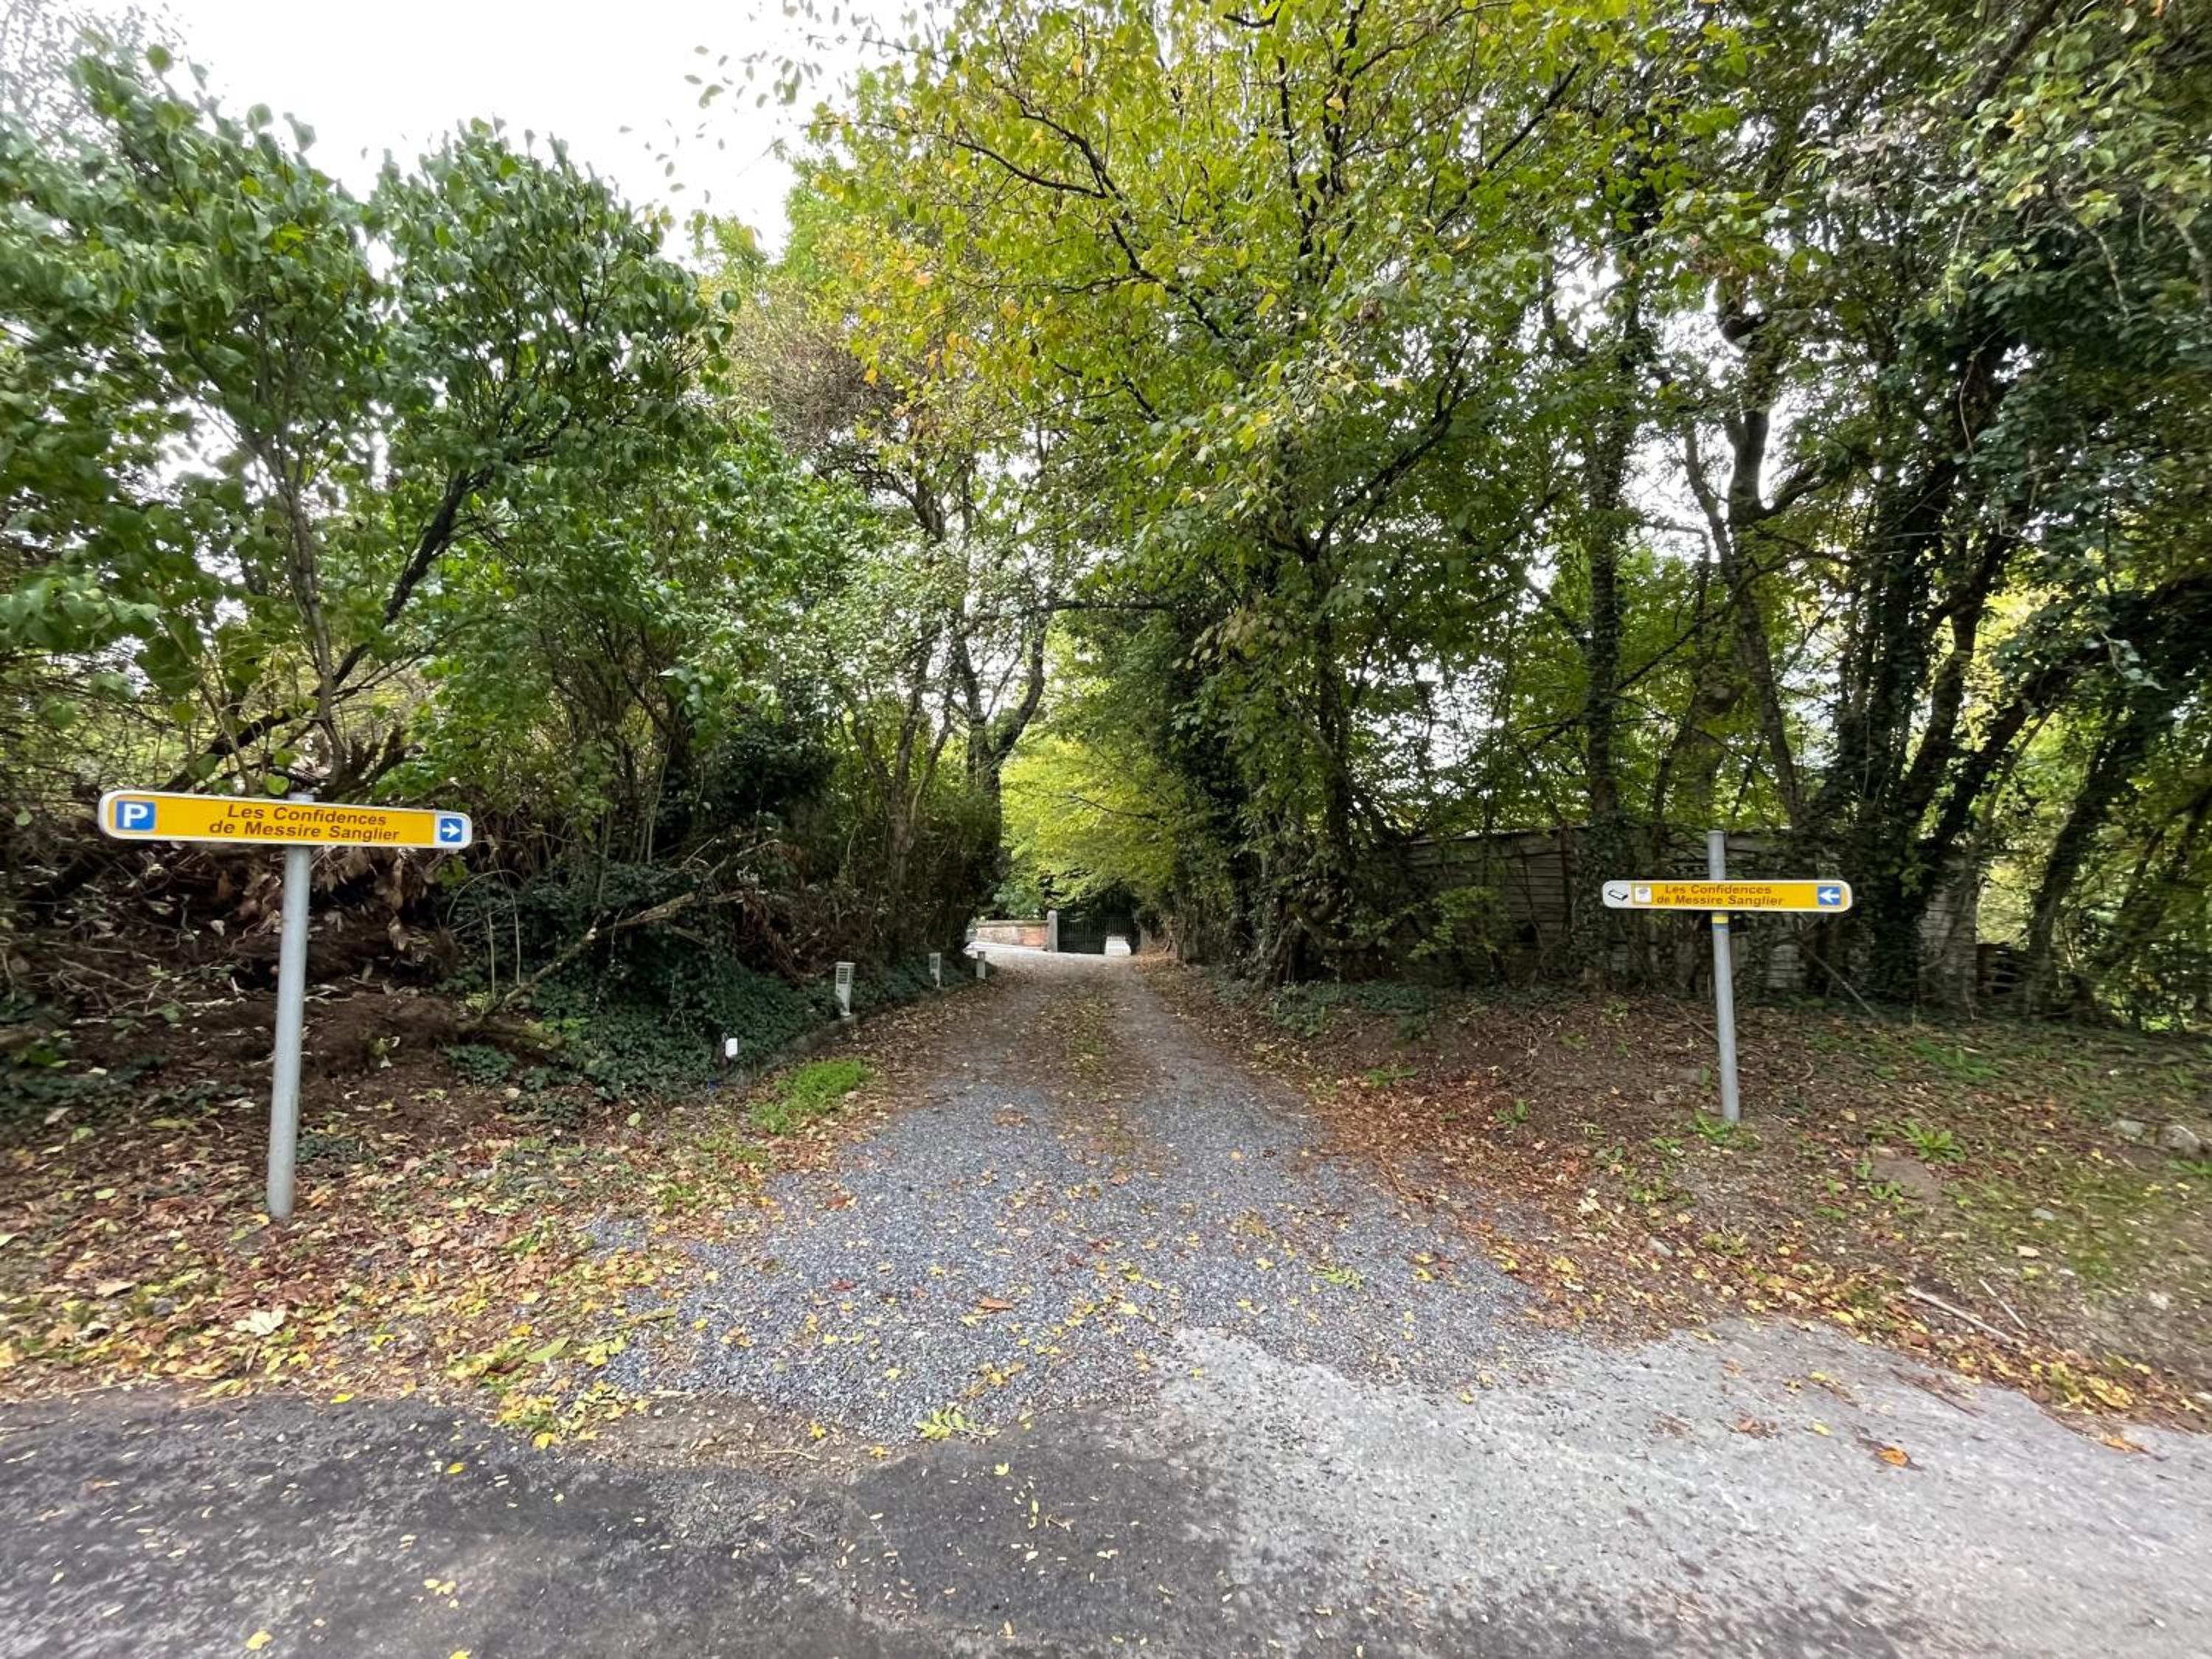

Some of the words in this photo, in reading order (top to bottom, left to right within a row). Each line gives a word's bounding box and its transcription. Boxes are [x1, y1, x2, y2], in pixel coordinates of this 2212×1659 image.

[124, 804, 147, 827] P
[227, 804, 265, 819] Les
[273, 806, 387, 826] Confidences
[209, 821, 235, 835] de
[243, 821, 321, 838] Messire
[328, 825, 399, 842] Sanglier
[1665, 885, 1686, 894] Les
[1690, 884, 1772, 894] Confidences
[1657, 895, 1672, 904] de
[1674, 895, 1724, 905] Messire
[1728, 895, 1784, 906] Sanglier
